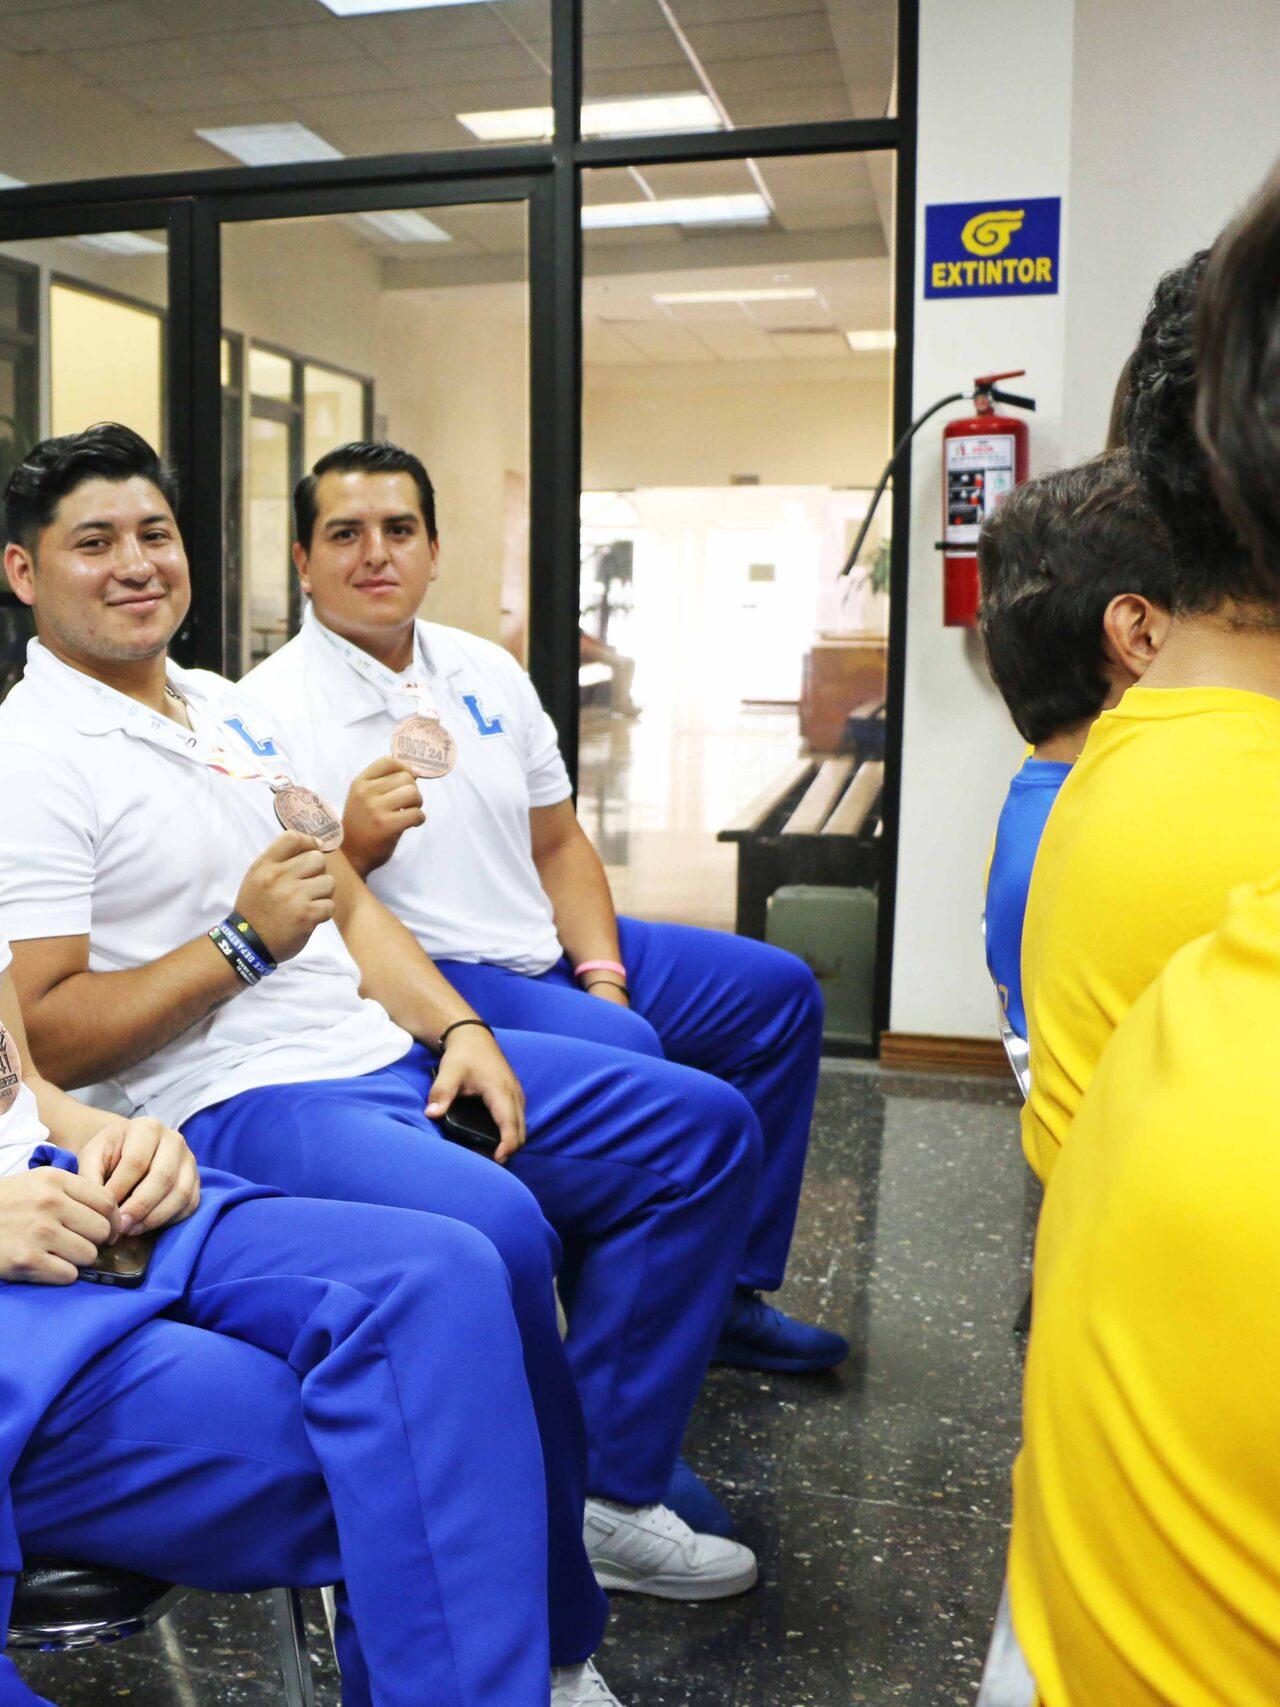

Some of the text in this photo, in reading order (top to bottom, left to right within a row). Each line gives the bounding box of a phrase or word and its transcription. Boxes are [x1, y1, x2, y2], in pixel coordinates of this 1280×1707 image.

[932, 257, 1052, 288] EXTINTOR
[223, 714, 278, 757] L
[461, 693, 505, 738] L
